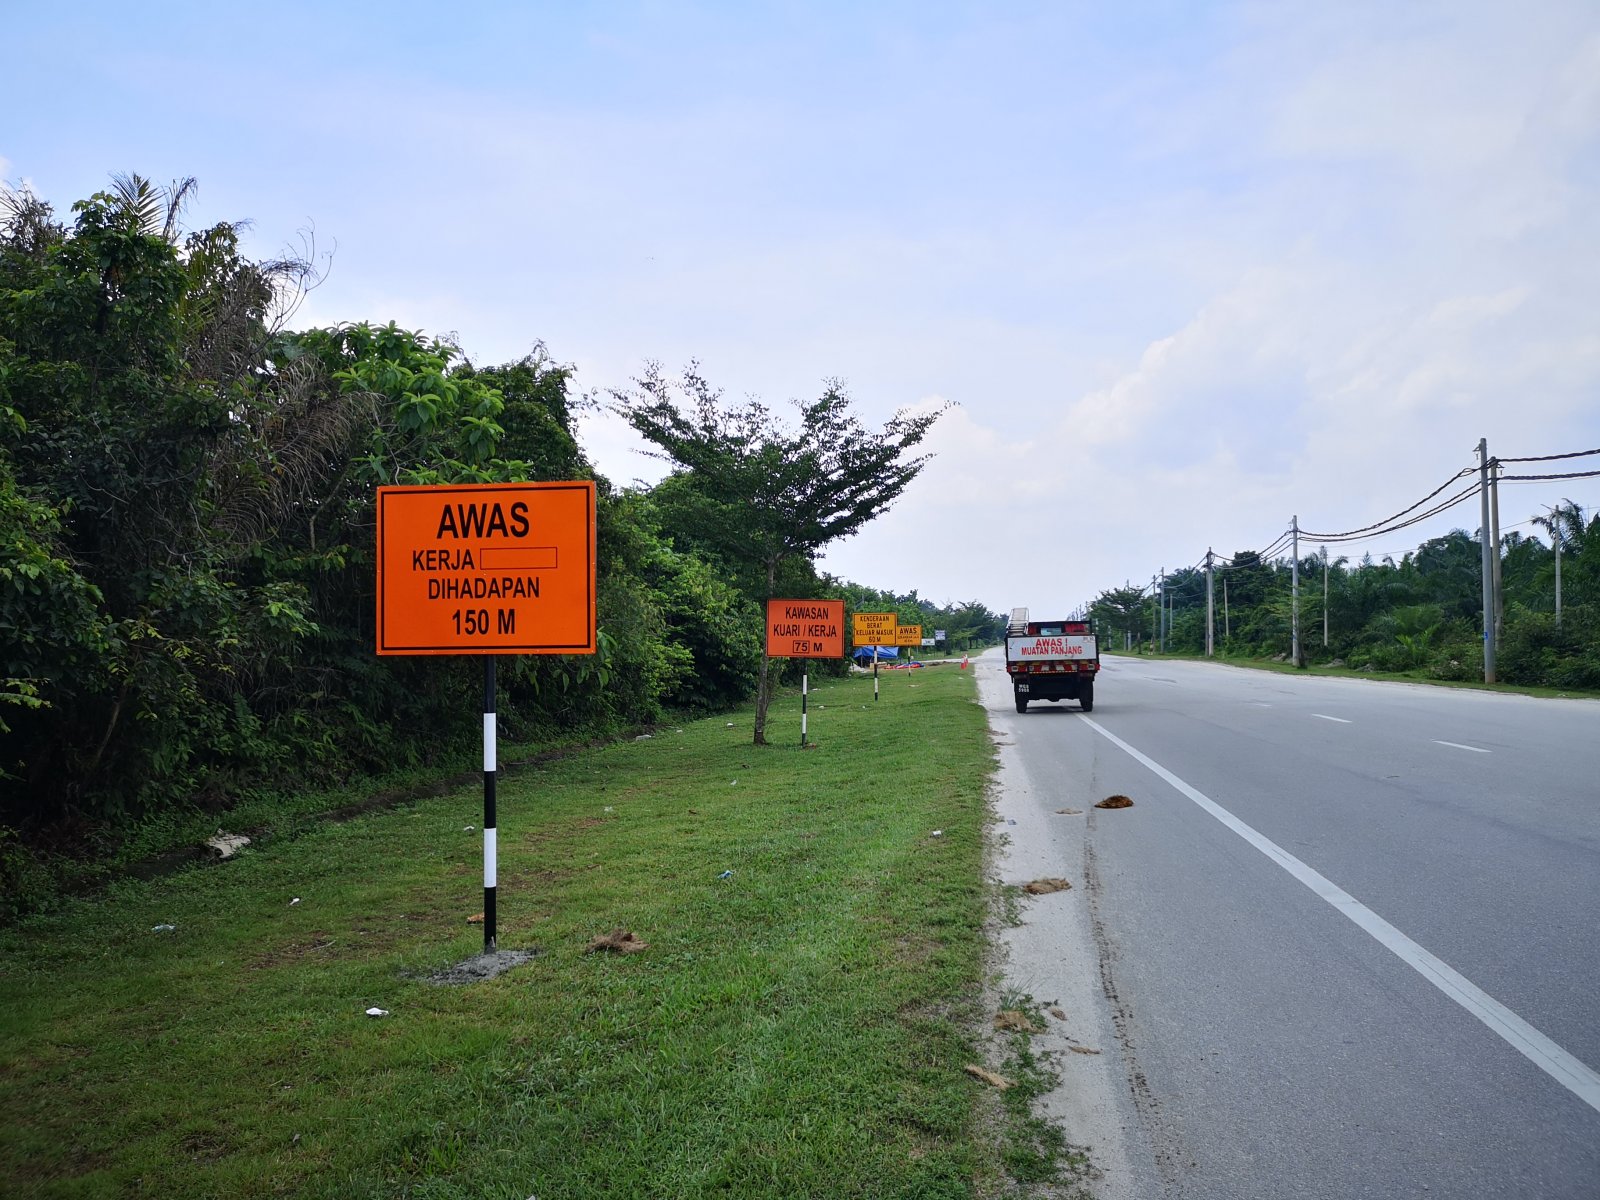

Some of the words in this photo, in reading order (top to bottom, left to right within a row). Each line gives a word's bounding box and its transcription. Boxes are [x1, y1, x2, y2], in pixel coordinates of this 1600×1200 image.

[437, 502, 530, 539] AWAS
[412, 549, 475, 571] KERJA
[428, 577, 540, 600] DIHADAPAN
[785, 607, 829, 620] KAWASAN
[452, 609, 489, 635] 150
[498, 609, 515, 635] M
[773, 624, 800, 636] KUARI
[808, 624, 837, 637] KERJA
[795, 642, 808, 652] 75
[813, 642, 823, 652] M
[1036, 638, 1062, 646] AWAS
[1022, 647, 1048, 655] MUATAN
[1051, 646, 1082, 654] PANJANG
